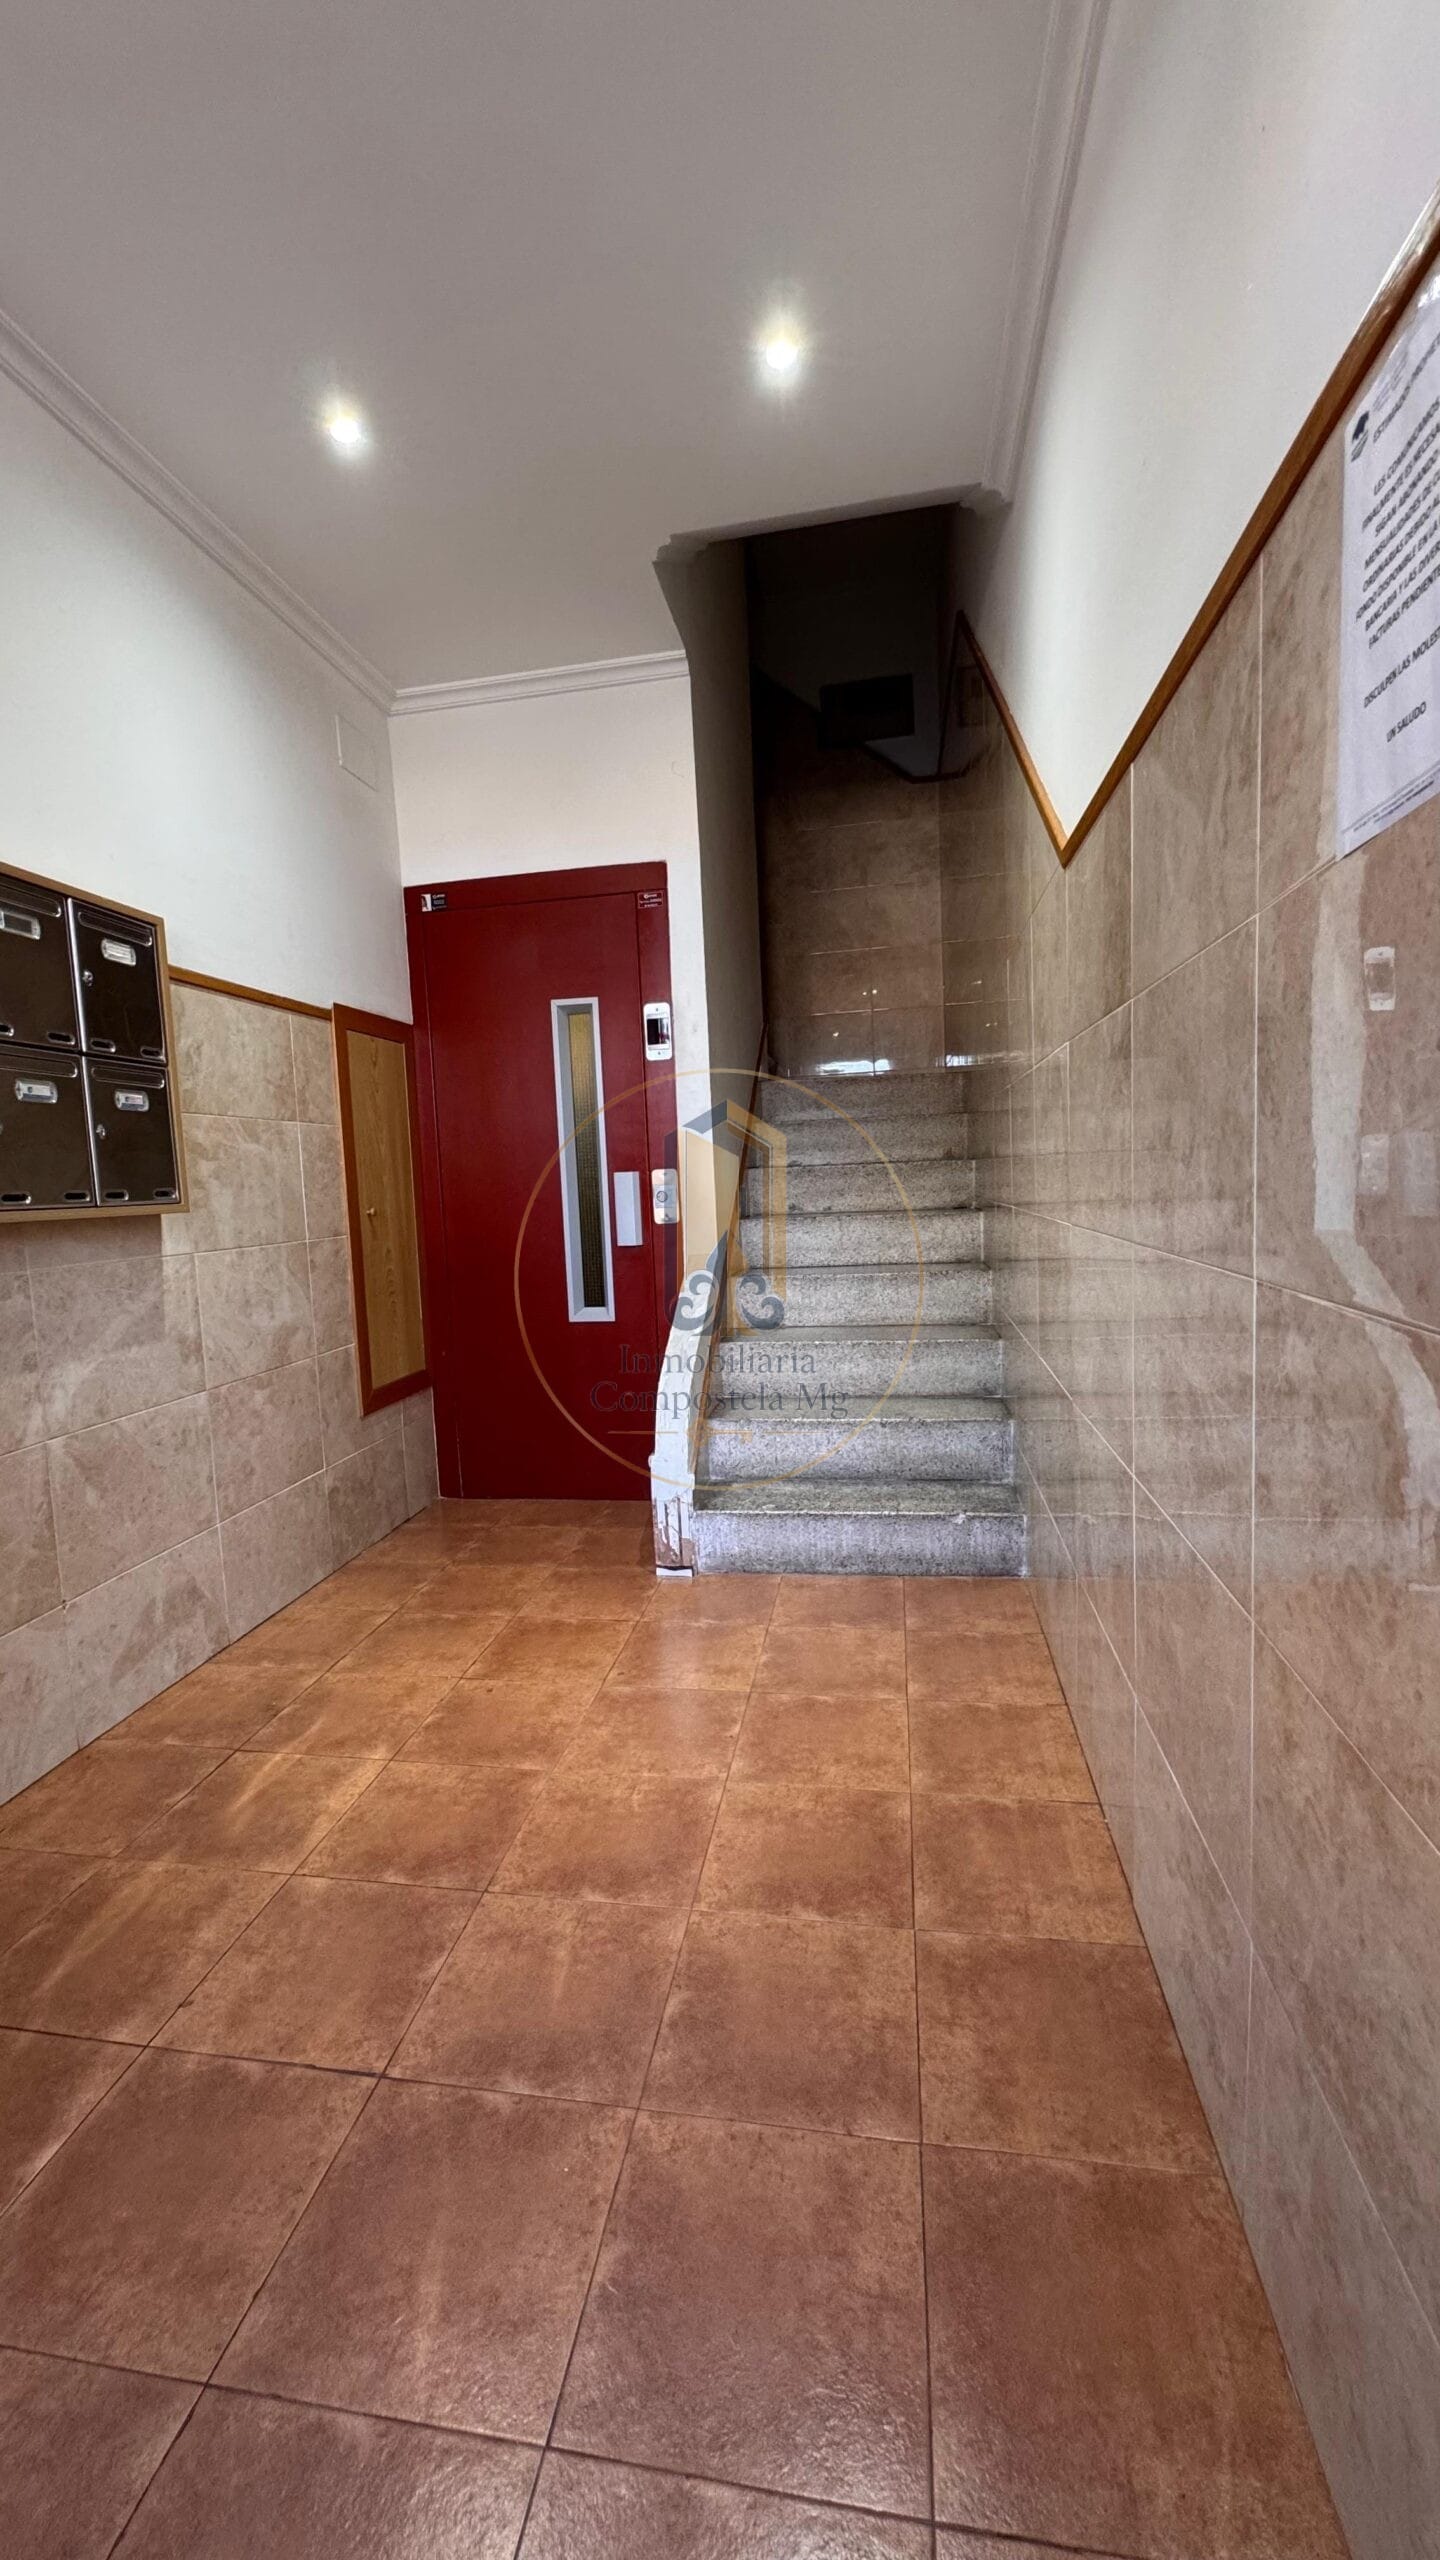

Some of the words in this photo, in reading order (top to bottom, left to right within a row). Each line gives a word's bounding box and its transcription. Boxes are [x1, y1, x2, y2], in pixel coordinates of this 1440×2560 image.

[1403, 567, 1416, 589] LAS
[1363, 668, 1396, 707] DISCULPEN
[1397, 654, 1411, 675] LAS
[1396, 700, 1426, 733] SALUDO
